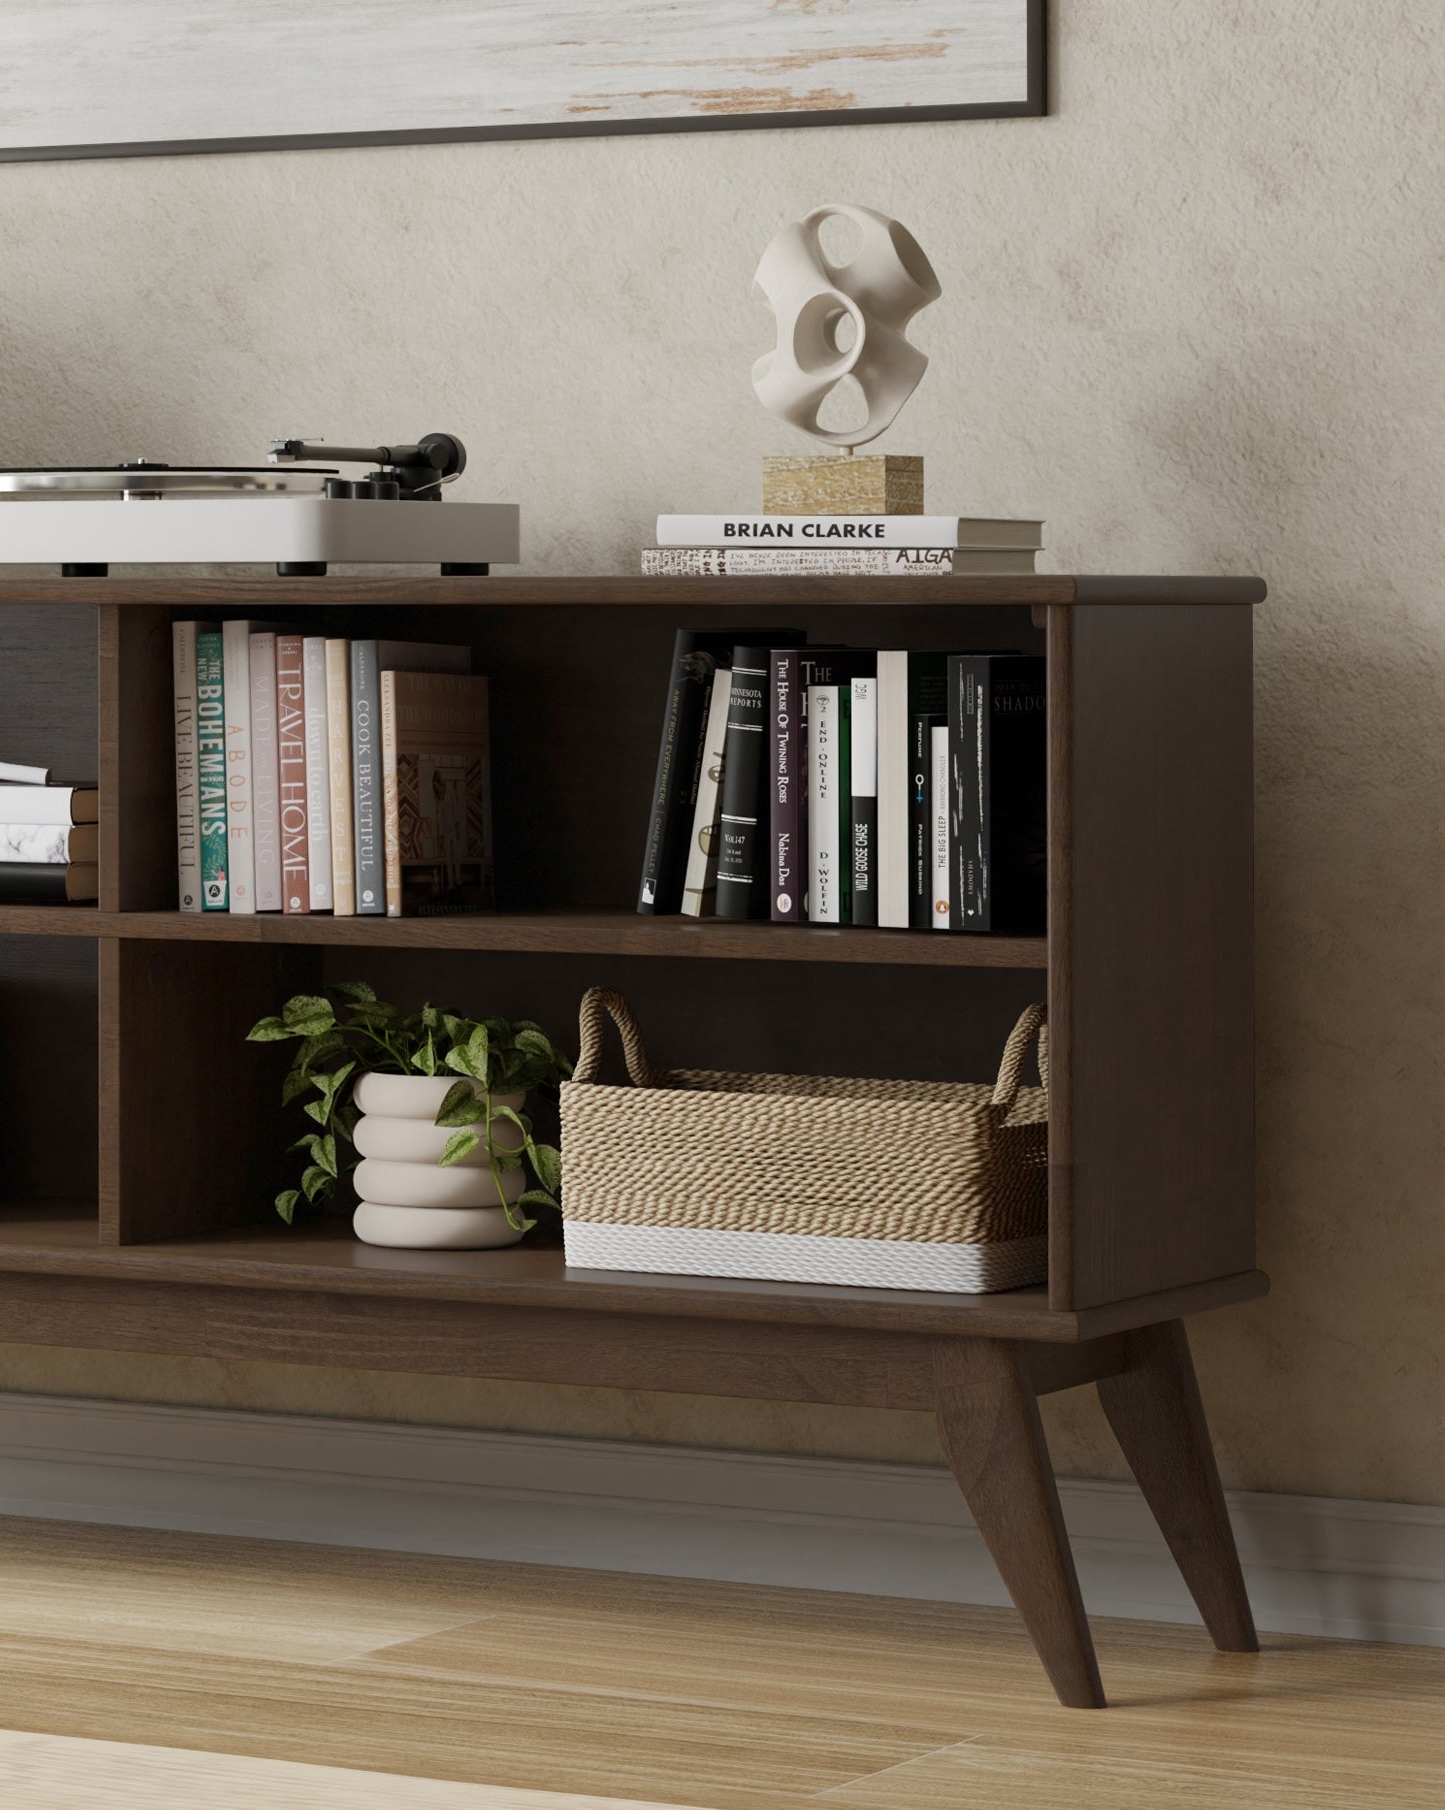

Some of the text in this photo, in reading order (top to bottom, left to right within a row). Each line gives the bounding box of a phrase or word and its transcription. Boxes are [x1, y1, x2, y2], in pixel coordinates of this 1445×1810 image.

[723, 523, 886, 538] BRIAN CLARKE
[896, 549, 953, 565] AIGA
[197, 657, 209, 682] NEW
[208, 659, 221, 681] THE
[800, 661, 833, 686] THE
[854, 684, 868, 701] WGC
[254, 675, 273, 746] MADE
[278, 664, 304, 774] TRAVEL
[777, 658, 789, 804] THE HOUSE OF TWINING ROSES
[818, 720, 828, 744] END
[198, 684, 227, 836] BOHEMIANS
[228, 724, 249, 839] ABODE
[308, 706, 329, 842] down to earth
[332, 699, 347, 862] HARVEST
[657, 689, 682, 807] AWAY FROM EVERYWHERE
[176, 696, 196, 875] LIVE BEAUTIFUL
[357, 699, 374, 871] COOK BEAUTIFUL
[257, 775, 275, 864] LIVING
[281, 782, 307, 881] HOME
[648, 817, 662, 874] CHAD PELLEY
[938, 815, 946, 837] SLEEP
[938, 839, 946, 853] BIG
[778, 833, 790, 886] Nabina Das
[855, 823, 869, 891] WILD GOOSE CHASE
[938, 855, 947, 869] THE
